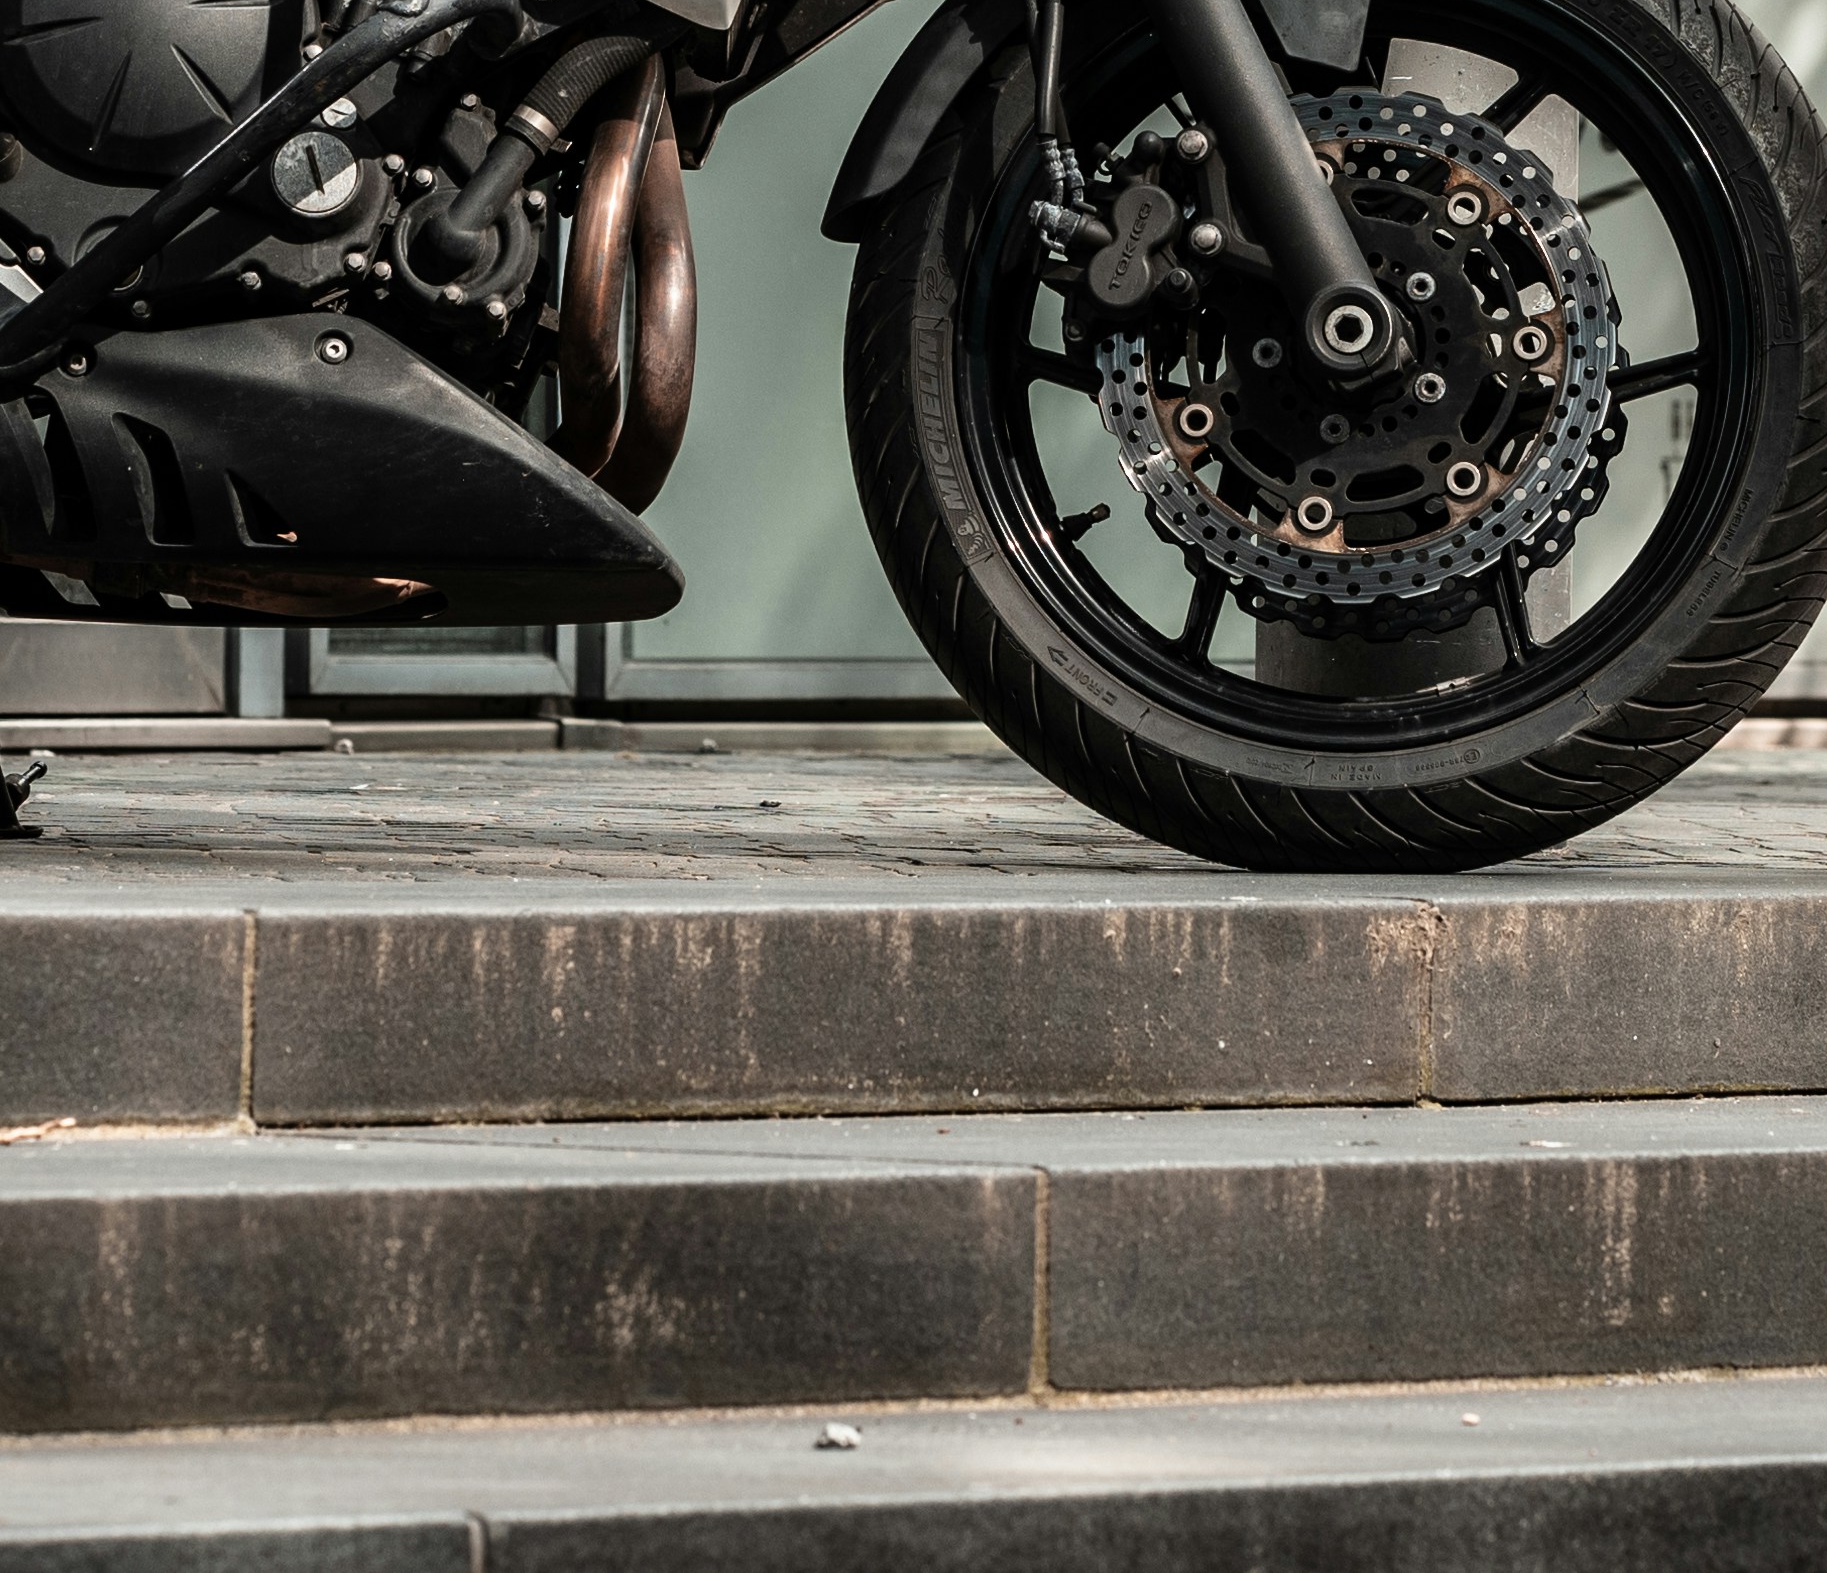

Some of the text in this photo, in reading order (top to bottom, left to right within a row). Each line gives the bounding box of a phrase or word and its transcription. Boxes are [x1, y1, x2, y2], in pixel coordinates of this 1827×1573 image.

[1108, 200, 1153, 292] TOKICO
[917, 328, 971, 515] MICHELIN
[1721, 486, 1754, 542] MICHELIN
[1683, 568, 1722, 618] TUBELESS
[1065, 662, 1104, 699] FRONT
[1329, 771, 1342, 781] IN
